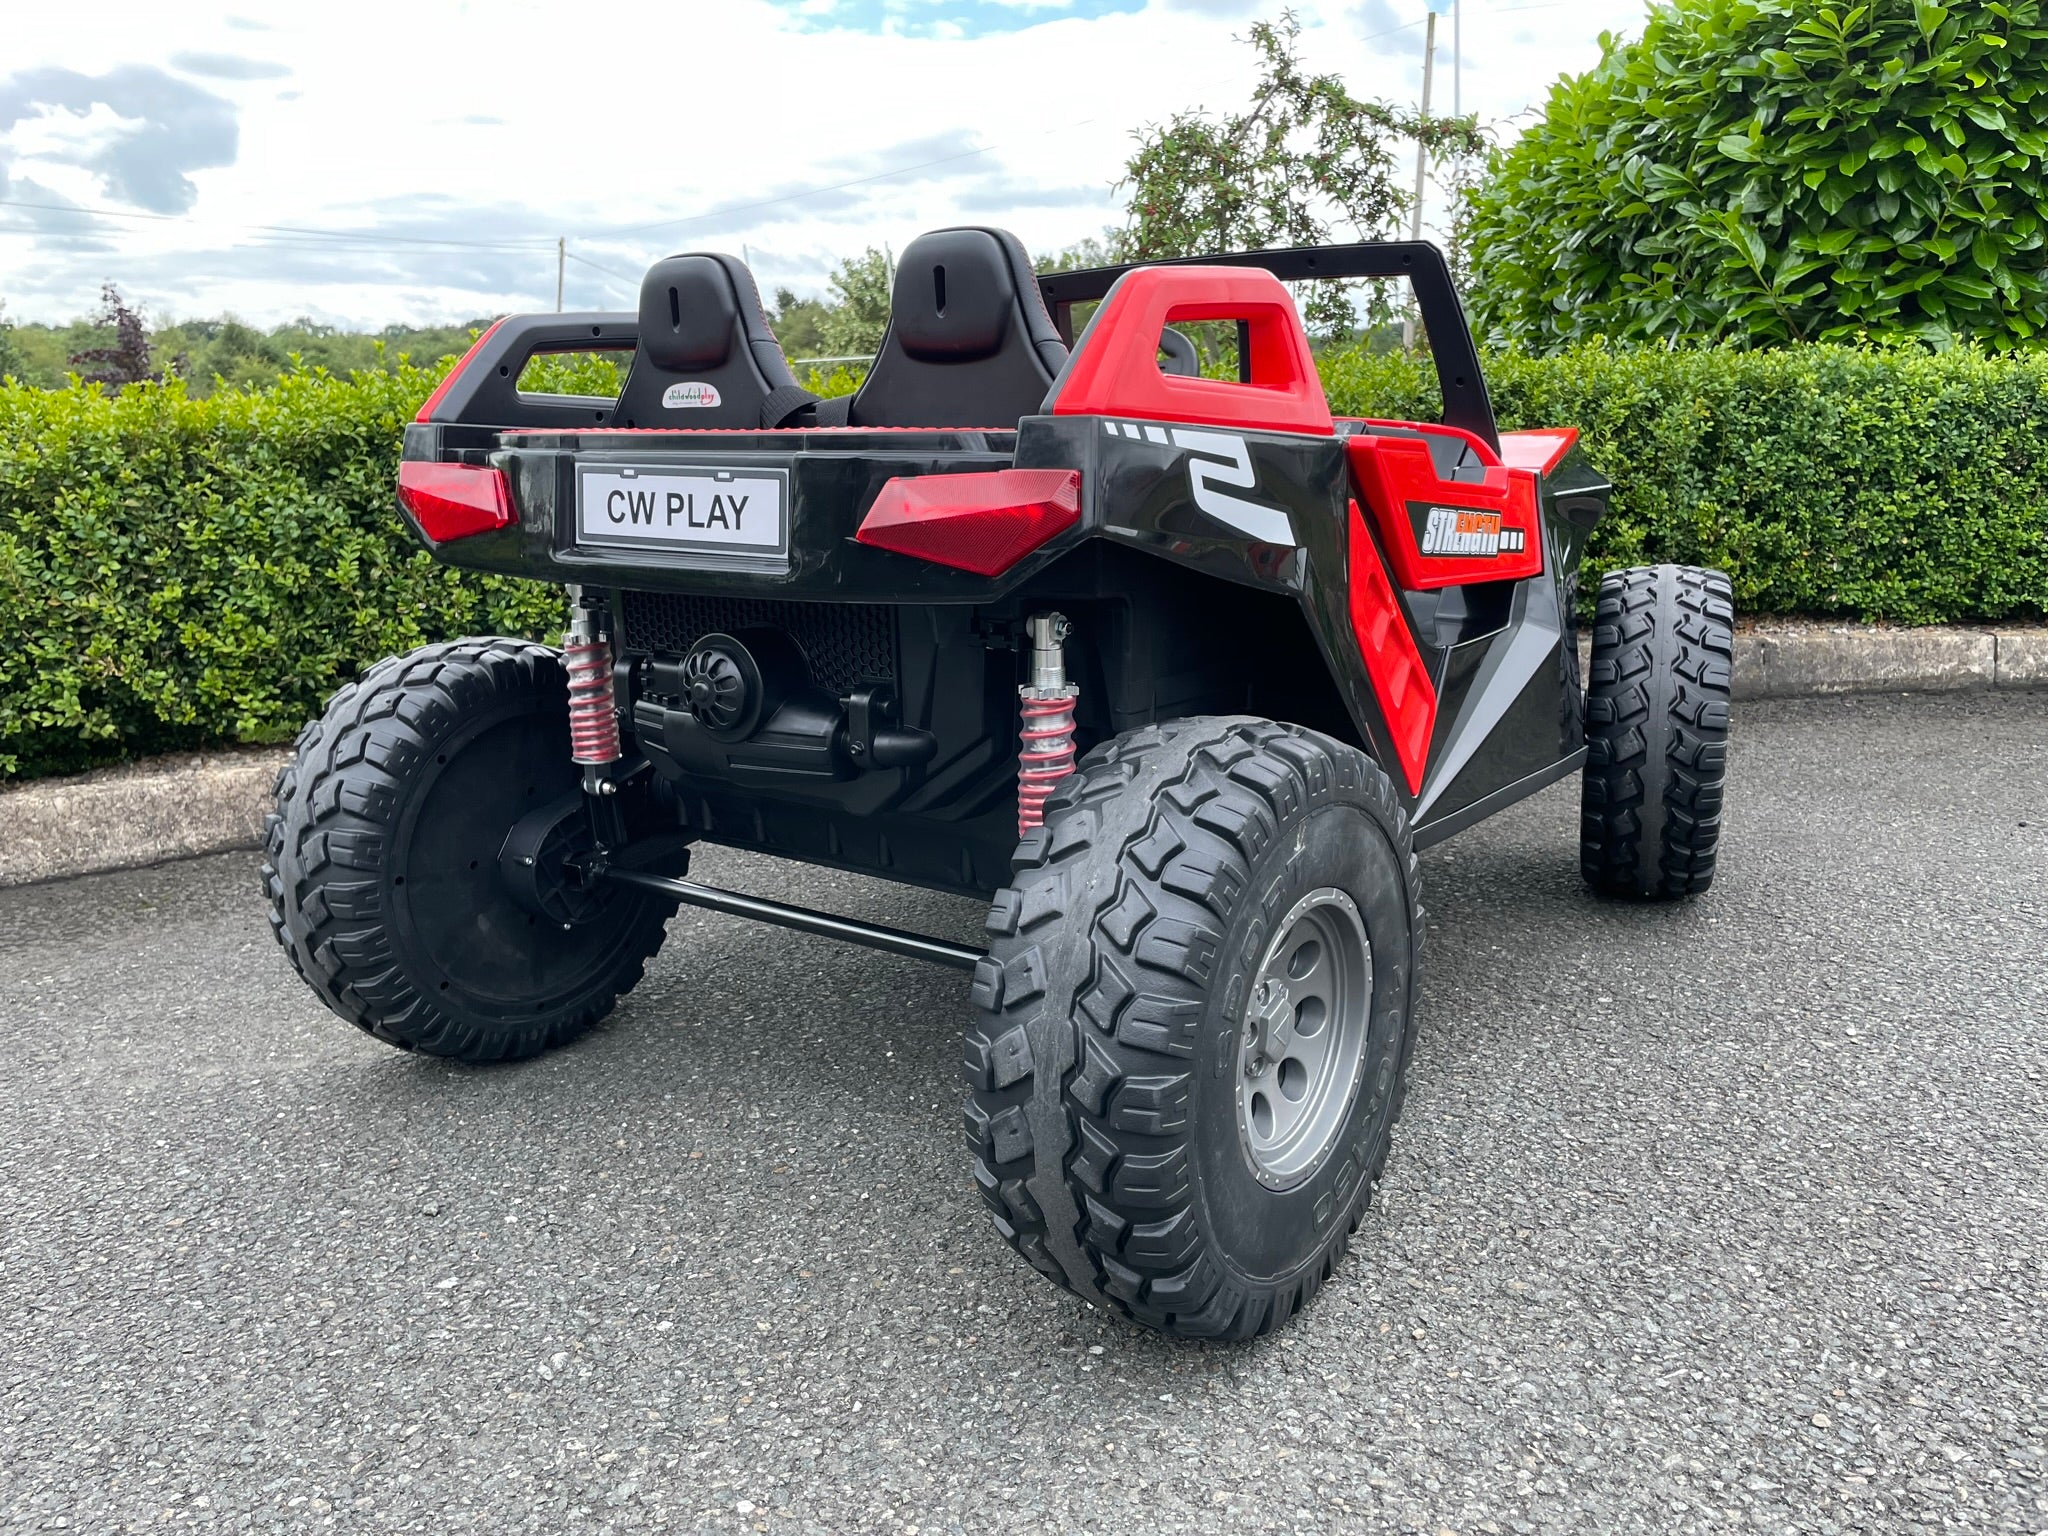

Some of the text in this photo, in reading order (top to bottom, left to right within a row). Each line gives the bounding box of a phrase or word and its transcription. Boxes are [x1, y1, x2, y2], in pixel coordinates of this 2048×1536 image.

[607, 489, 749, 530] CW PLAY
[1422, 507, 1501, 555] STRENGTH
